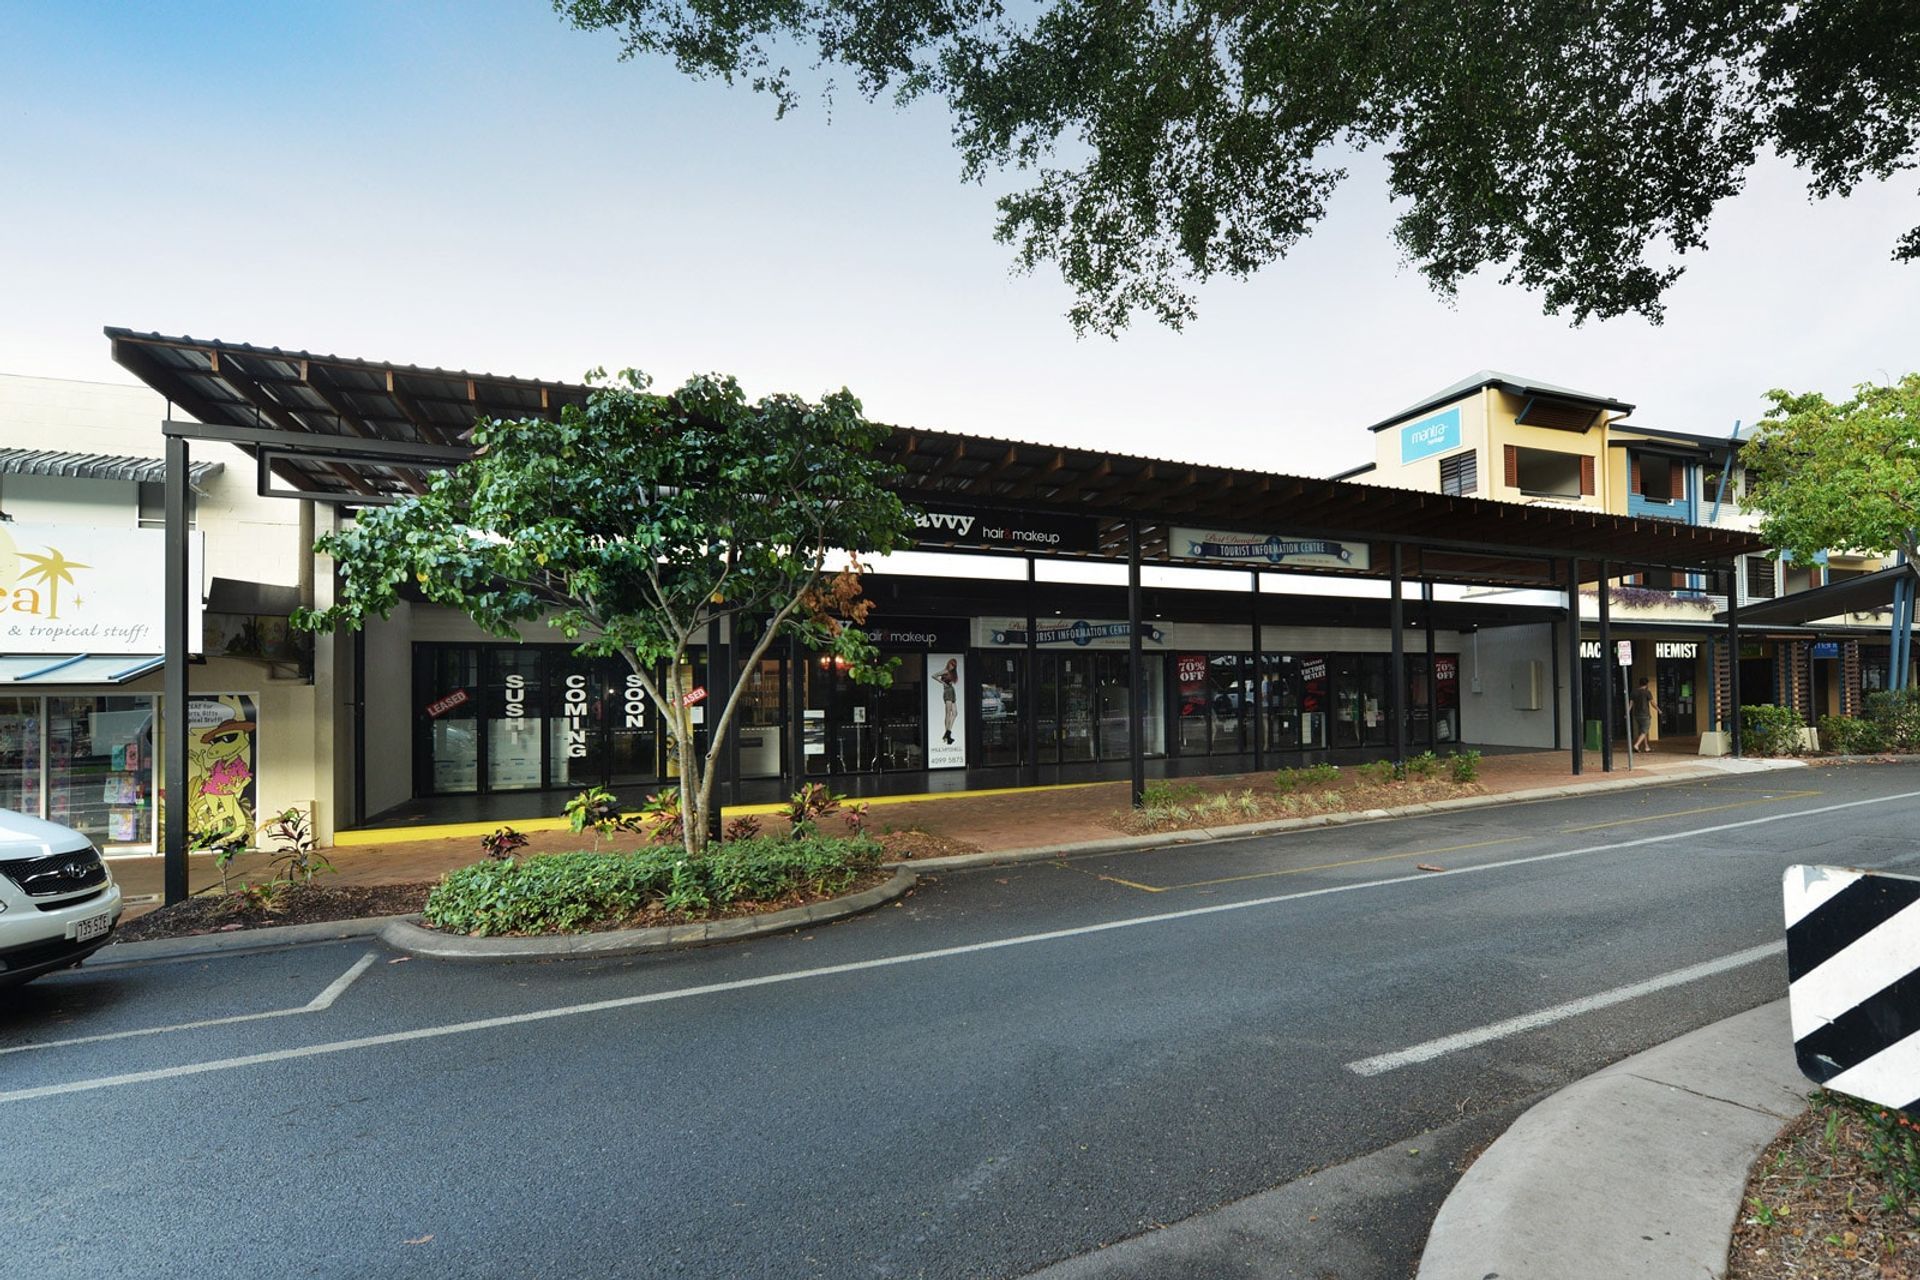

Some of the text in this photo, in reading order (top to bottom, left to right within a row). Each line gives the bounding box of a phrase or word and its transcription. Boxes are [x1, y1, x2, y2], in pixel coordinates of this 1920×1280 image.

[1411, 423, 1446, 445] mantra
[914, 513, 975, 536] avvy
[1220, 542, 1325, 556] TOURIST INFORMATION CENTRE
[8, 624, 149, 643] & tropical stuff!
[1024, 624, 1131, 642] TURIST INFORMATION CENTR
[1178, 661, 1205, 672] 70%
[1435, 663, 1456, 672] 70%
[1436, 671, 1456, 680] OFF
[1179, 671, 1205, 682] OFF
[427, 691, 466, 716] LEASED
[505, 674, 524, 745] SUSHI
[624, 674, 645, 728] SOON
[564, 674, 588, 758] COMING
